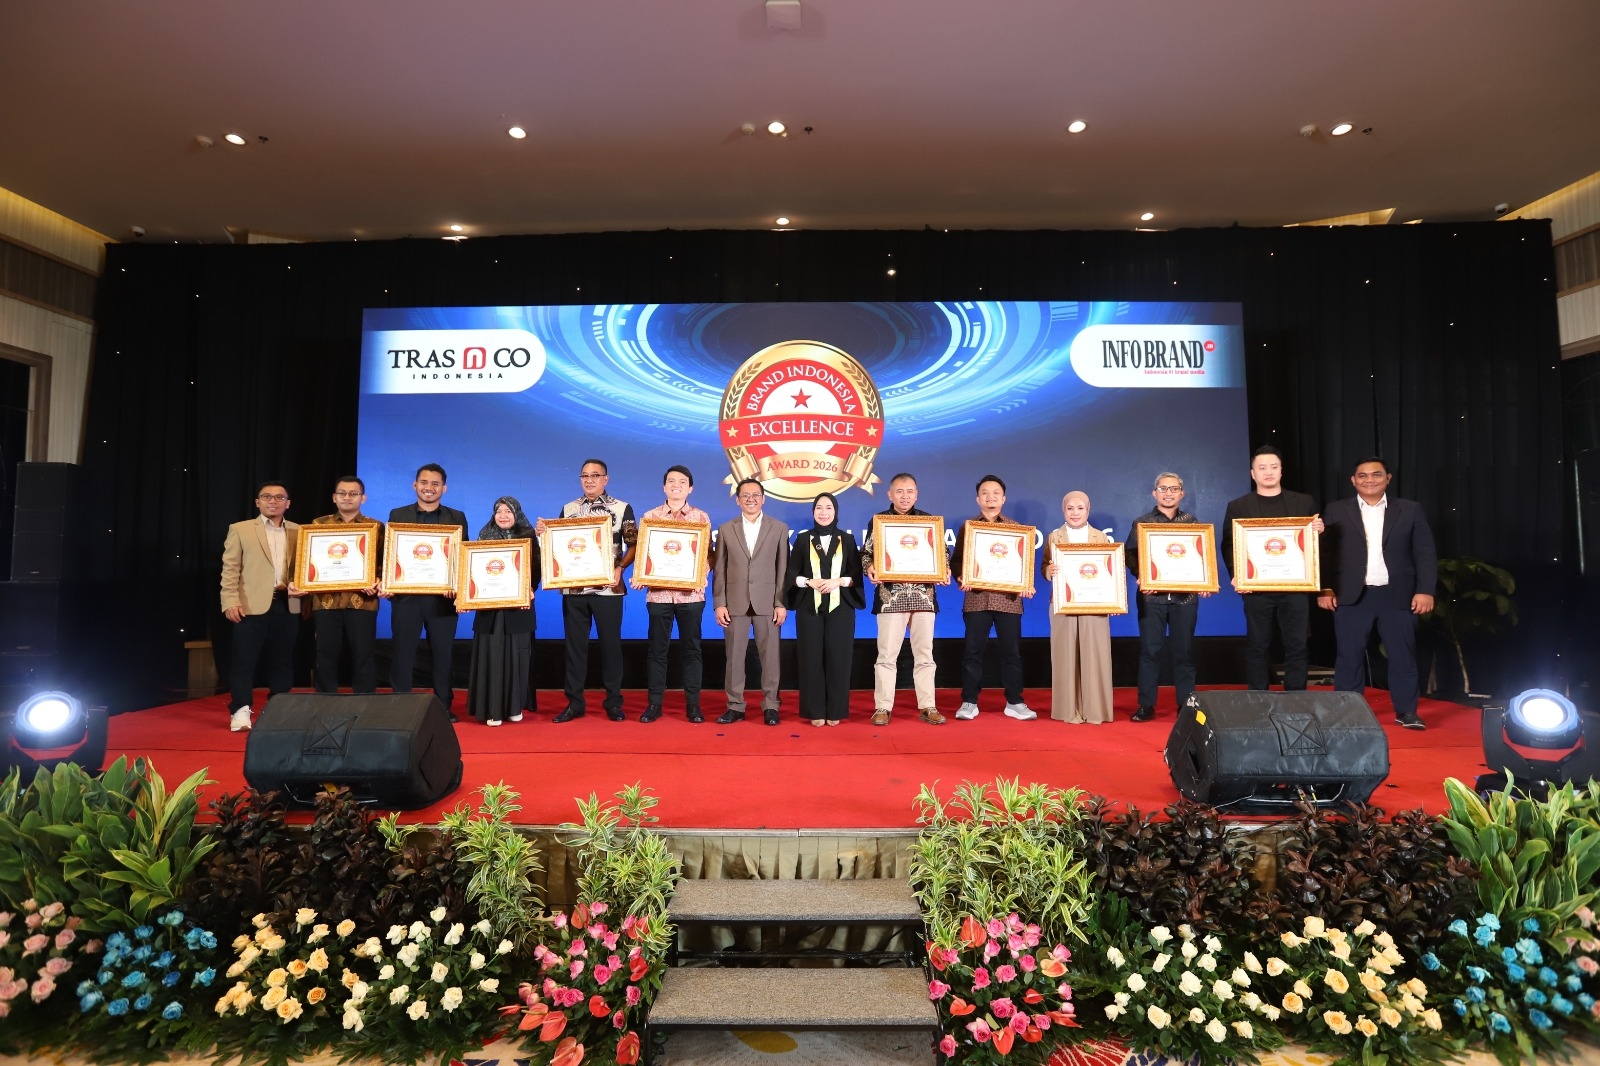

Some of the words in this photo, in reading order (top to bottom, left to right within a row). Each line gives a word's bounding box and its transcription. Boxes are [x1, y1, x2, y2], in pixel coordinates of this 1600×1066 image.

[387, 349, 456, 369] TRAS
[493, 347, 531, 368] CO
[746, 370, 785, 412] BRAND
[786, 364, 857, 413] INDONESIA
[748, 420, 855, 437] EXCELLENCE
[767, 459, 810, 472] AWARD
[812, 459, 839, 473] 2026
